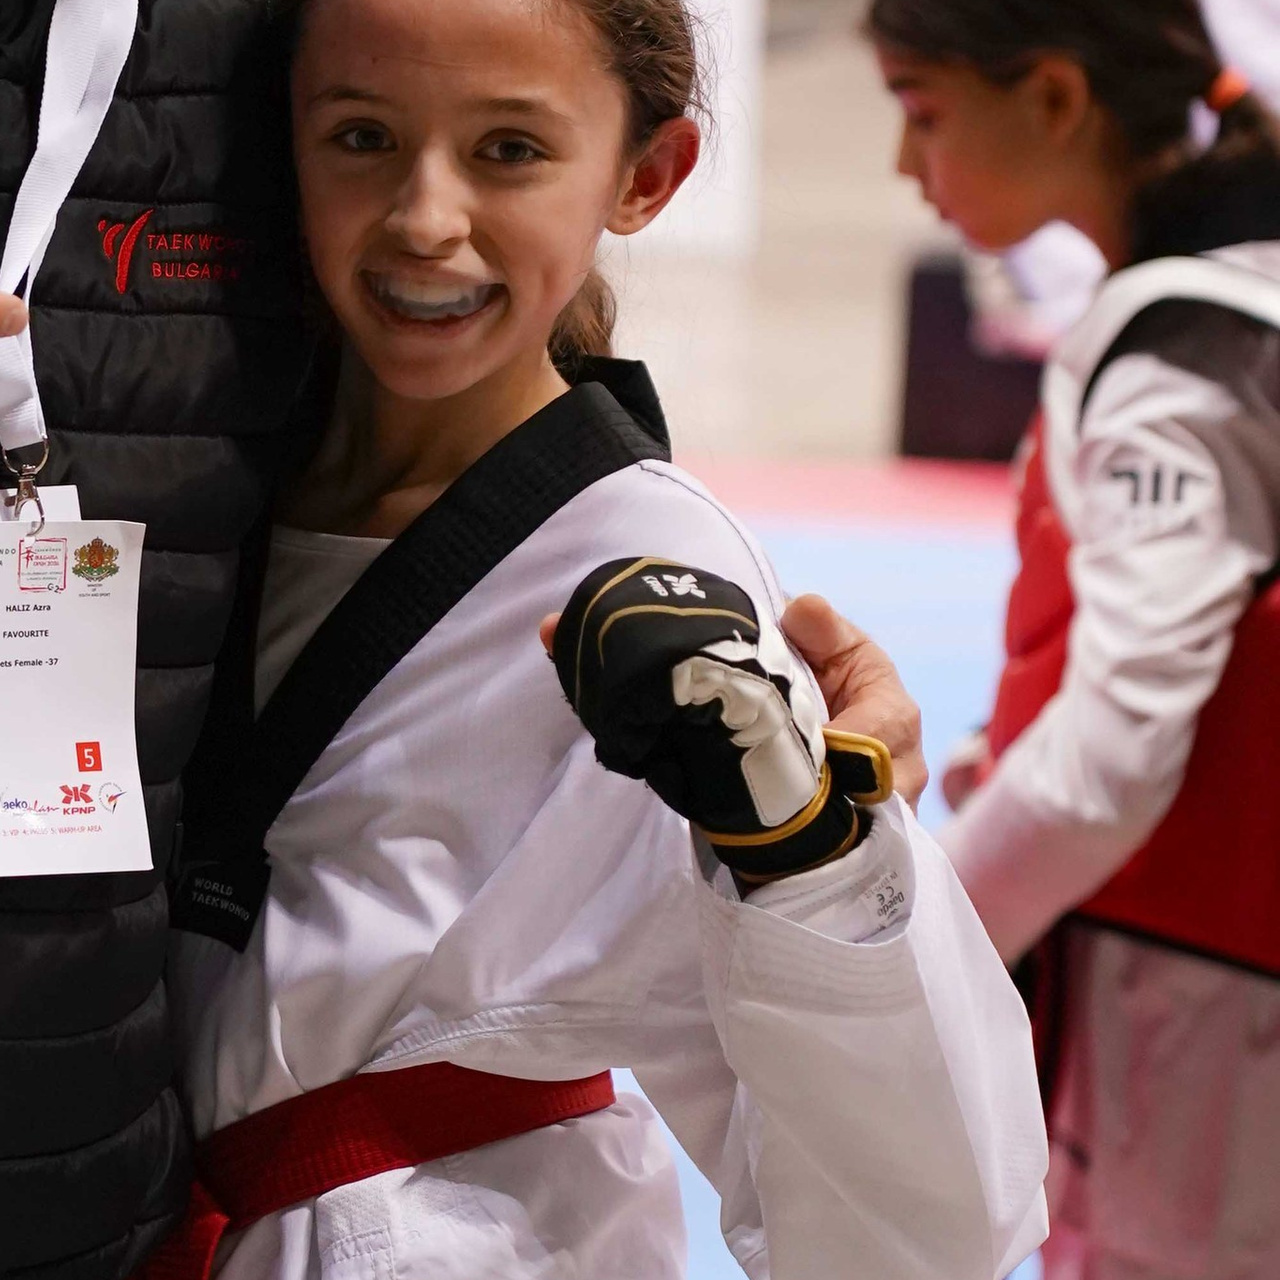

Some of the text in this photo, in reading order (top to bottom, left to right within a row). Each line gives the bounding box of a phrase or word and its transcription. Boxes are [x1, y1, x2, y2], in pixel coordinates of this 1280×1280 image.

[152, 262, 239, 279] BULGA
[6, 604, 31, 613] HALIZ
[33, 604, 52, 612] Azra
[3, 630, 49, 639] FAVOURITE
[14, 659, 43, 667] Female
[45, 658, 59, 666] -37
[84, 748, 95, 768] 5
[63, 806, 96, 816] KPNP
[194, 878, 233, 896] WORLD
[878, 891, 905, 917] Daedo
